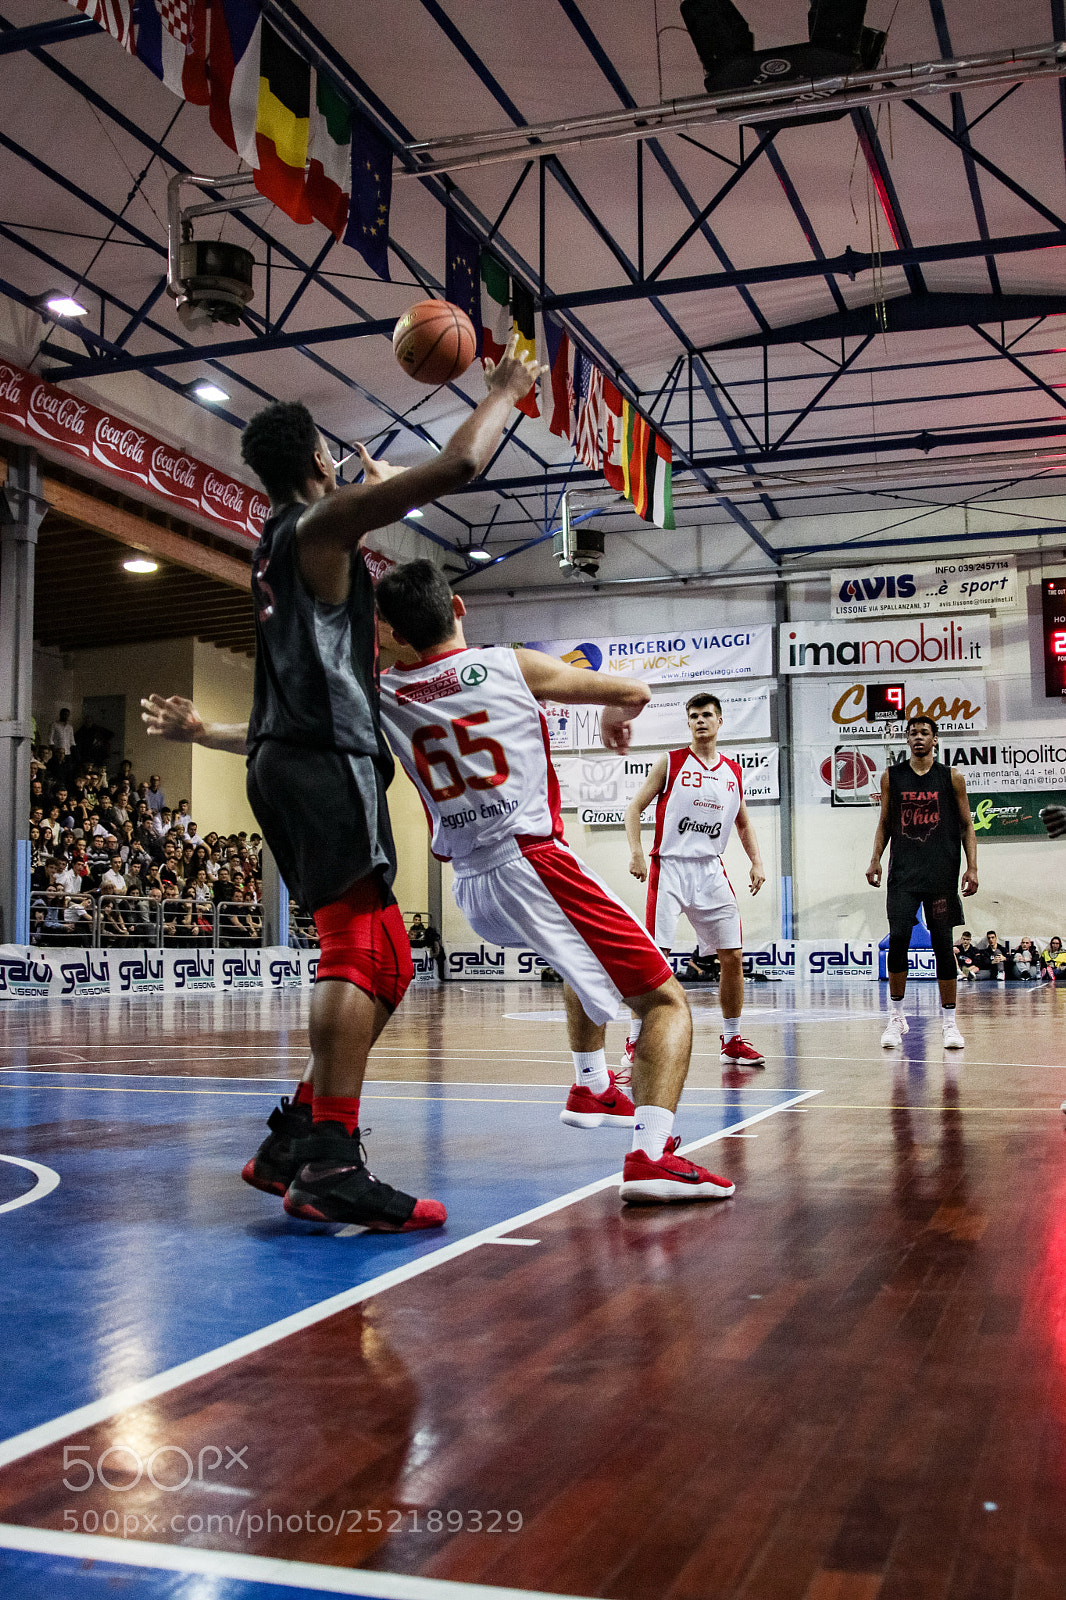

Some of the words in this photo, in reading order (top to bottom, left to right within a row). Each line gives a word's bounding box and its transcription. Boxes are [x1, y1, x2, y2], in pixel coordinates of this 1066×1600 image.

[935, 566, 956, 575] INFO
[838, 573, 917, 603] AVIS
[959, 576, 1009, 598] sport
[835, 605, 868, 615] LISSONE
[608, 638, 686, 656] FRIGERIO
[691, 633, 750, 650] VIAGGI
[788, 620, 982, 667] imamobili.it
[608, 655, 691, 673] NETWORK
[661, 666, 752, 680] www.frigerioviaggi.com
[831, 684, 982, 725] Coon
[886, 687, 903, 711] 9
[411, 709, 510, 803] 65
[681, 770, 703, 788] 23
[1024, 768, 1035, 776] 44
[901, 791, 939, 801] TEAM
[901, 807, 940, 827] Ohio
[985, 806, 1023, 814] SPORT
[222, 949, 261, 985] galvi
[449, 944, 505, 973] galvi
[809, 942, 873, 973] galvi
[60, 950, 110, 994] galvi
[118, 949, 164, 991] galvi
[173, 949, 215, 988] galvi
[9, 987, 49, 997] LISSONE
[74, 986, 111, 996] LISSONE
[131, 984, 165, 993] LISSONE
[187, 981, 216, 989] LISSONE
[233, 980, 264, 988] LISSONE
